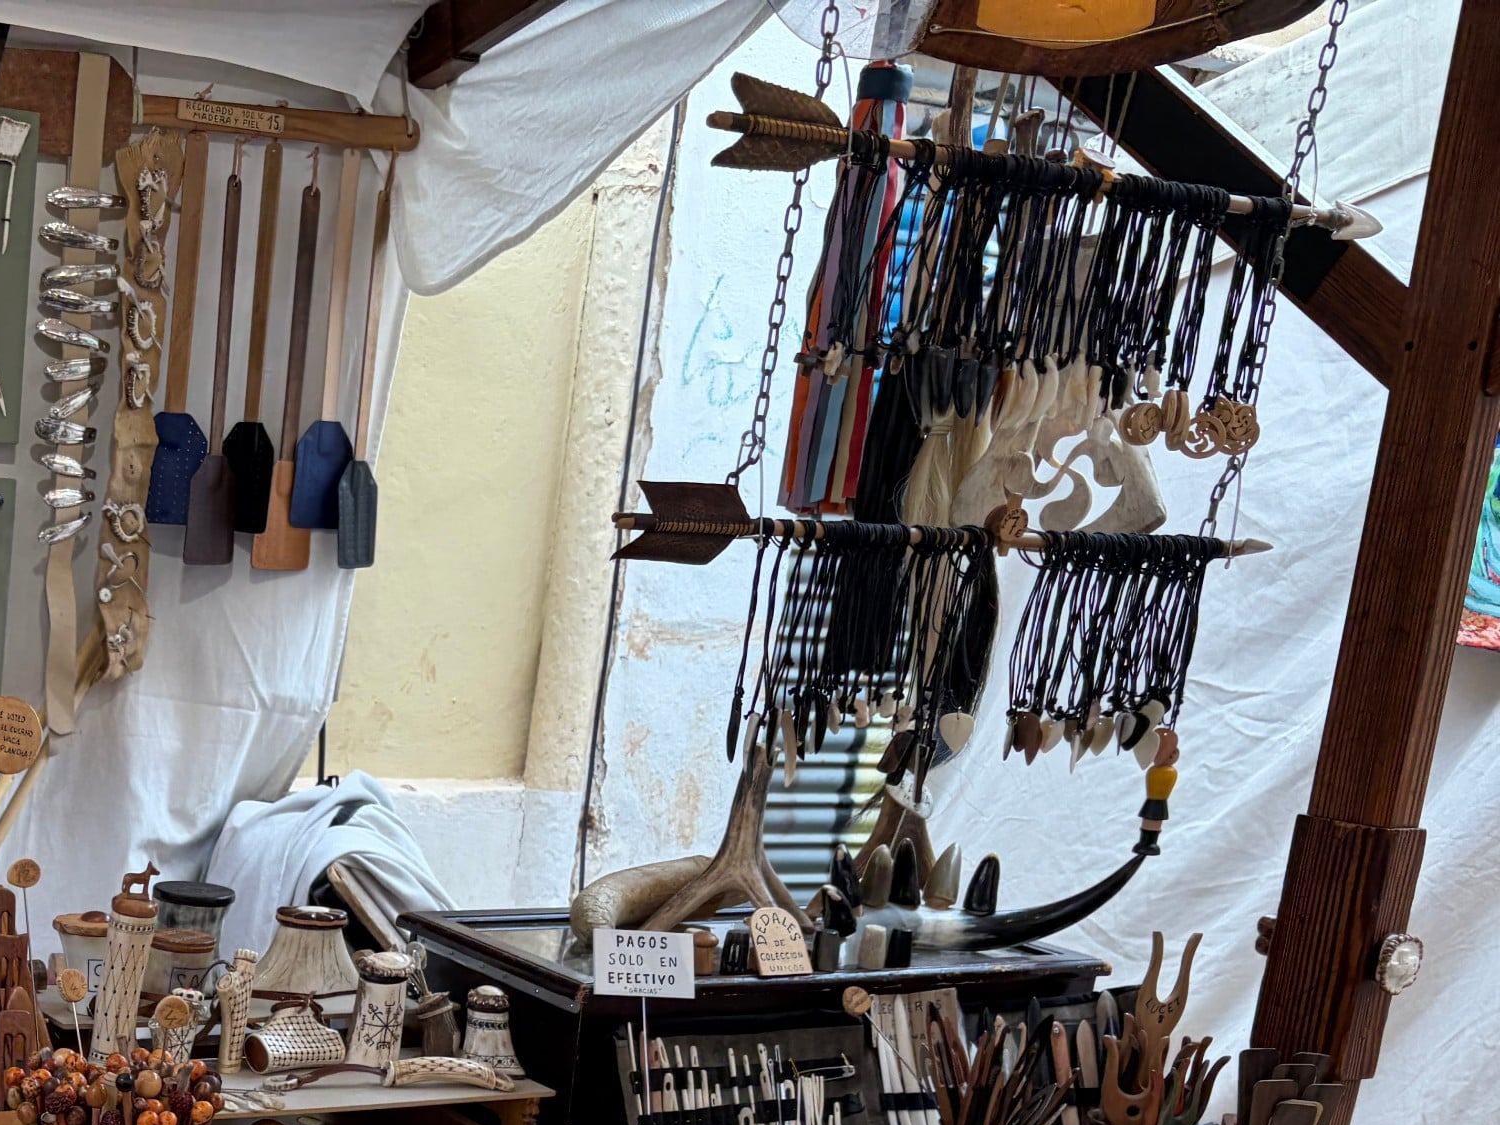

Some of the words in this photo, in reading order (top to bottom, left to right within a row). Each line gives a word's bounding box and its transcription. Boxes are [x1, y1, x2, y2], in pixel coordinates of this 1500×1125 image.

[193, 112, 231, 125] MADERA
[243, 119, 260, 130] PIEL
[756, 912, 801, 946] DEDALES
[616, 935, 668, 950] PAGOS
[609, 953, 643, 966] SOLO
[660, 957, 677, 968] EN
[608, 972, 675, 985] EFECTIVO
